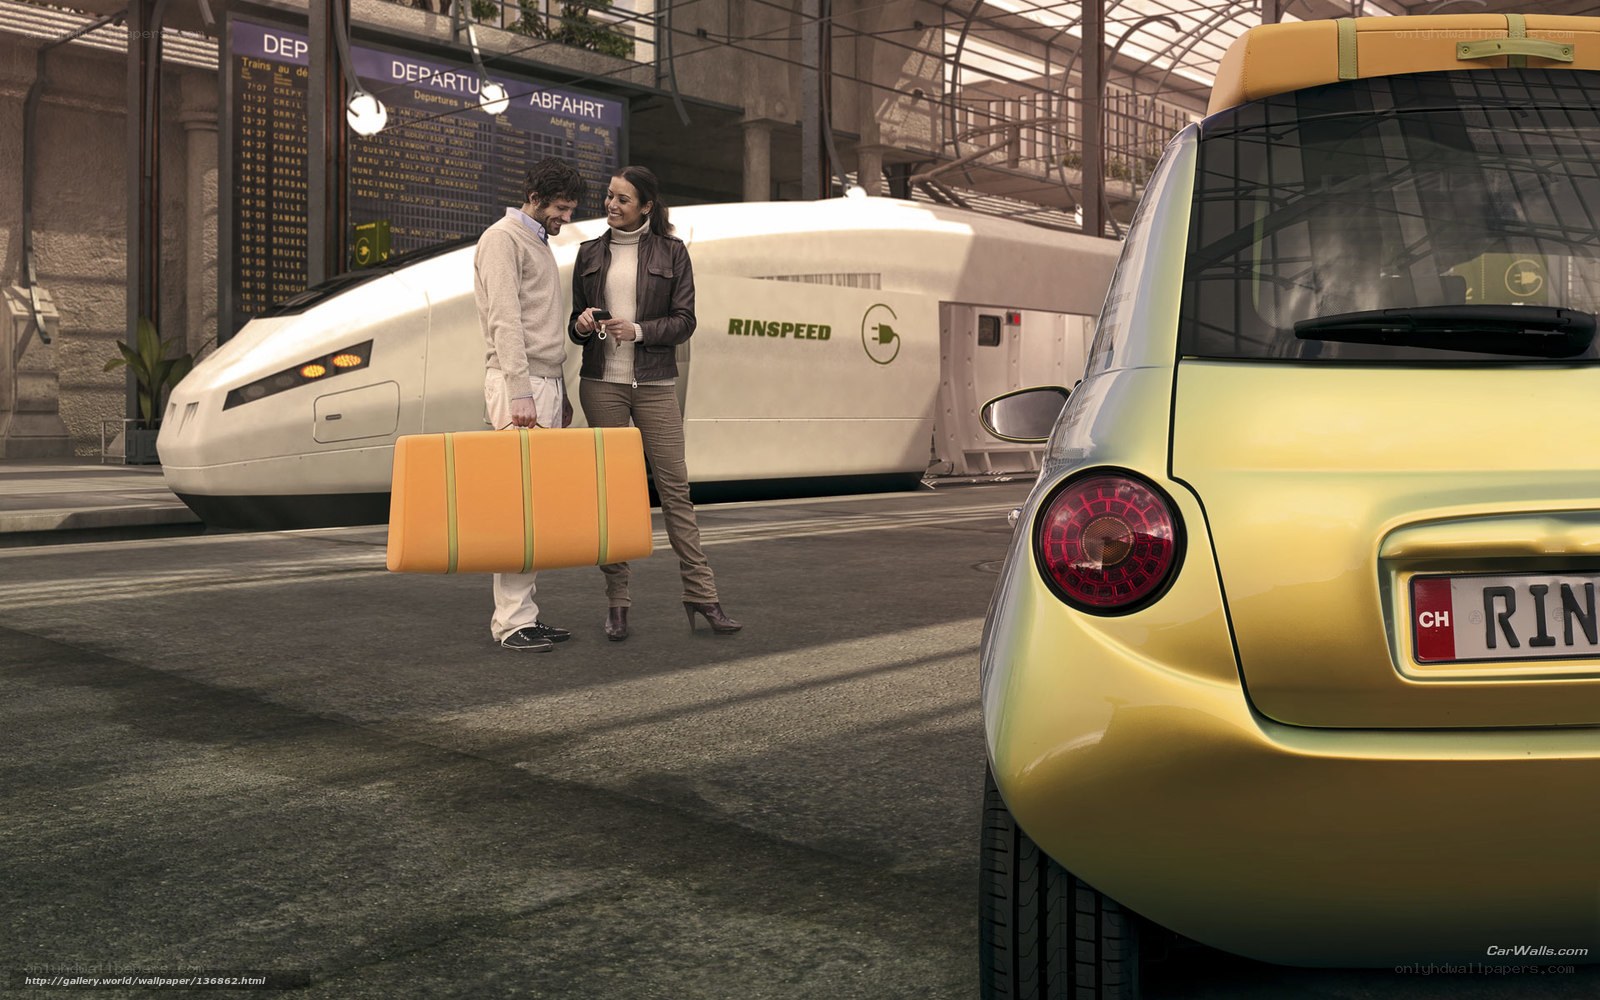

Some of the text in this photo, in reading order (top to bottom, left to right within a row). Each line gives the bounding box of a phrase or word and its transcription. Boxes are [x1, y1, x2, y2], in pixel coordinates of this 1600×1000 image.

[264, 33, 308, 59] DEP
[242, 56, 271, 71] Trains
[278, 65, 290, 74] au
[392, 60, 504, 95] DEPARTU
[414, 89, 458, 106] Departures
[530, 91, 604, 120] ABFAHRT
[550, 116, 576, 130] Abfahrt
[728, 318, 832, 341] RINSPEED
[1418, 610, 1450, 628] CH
